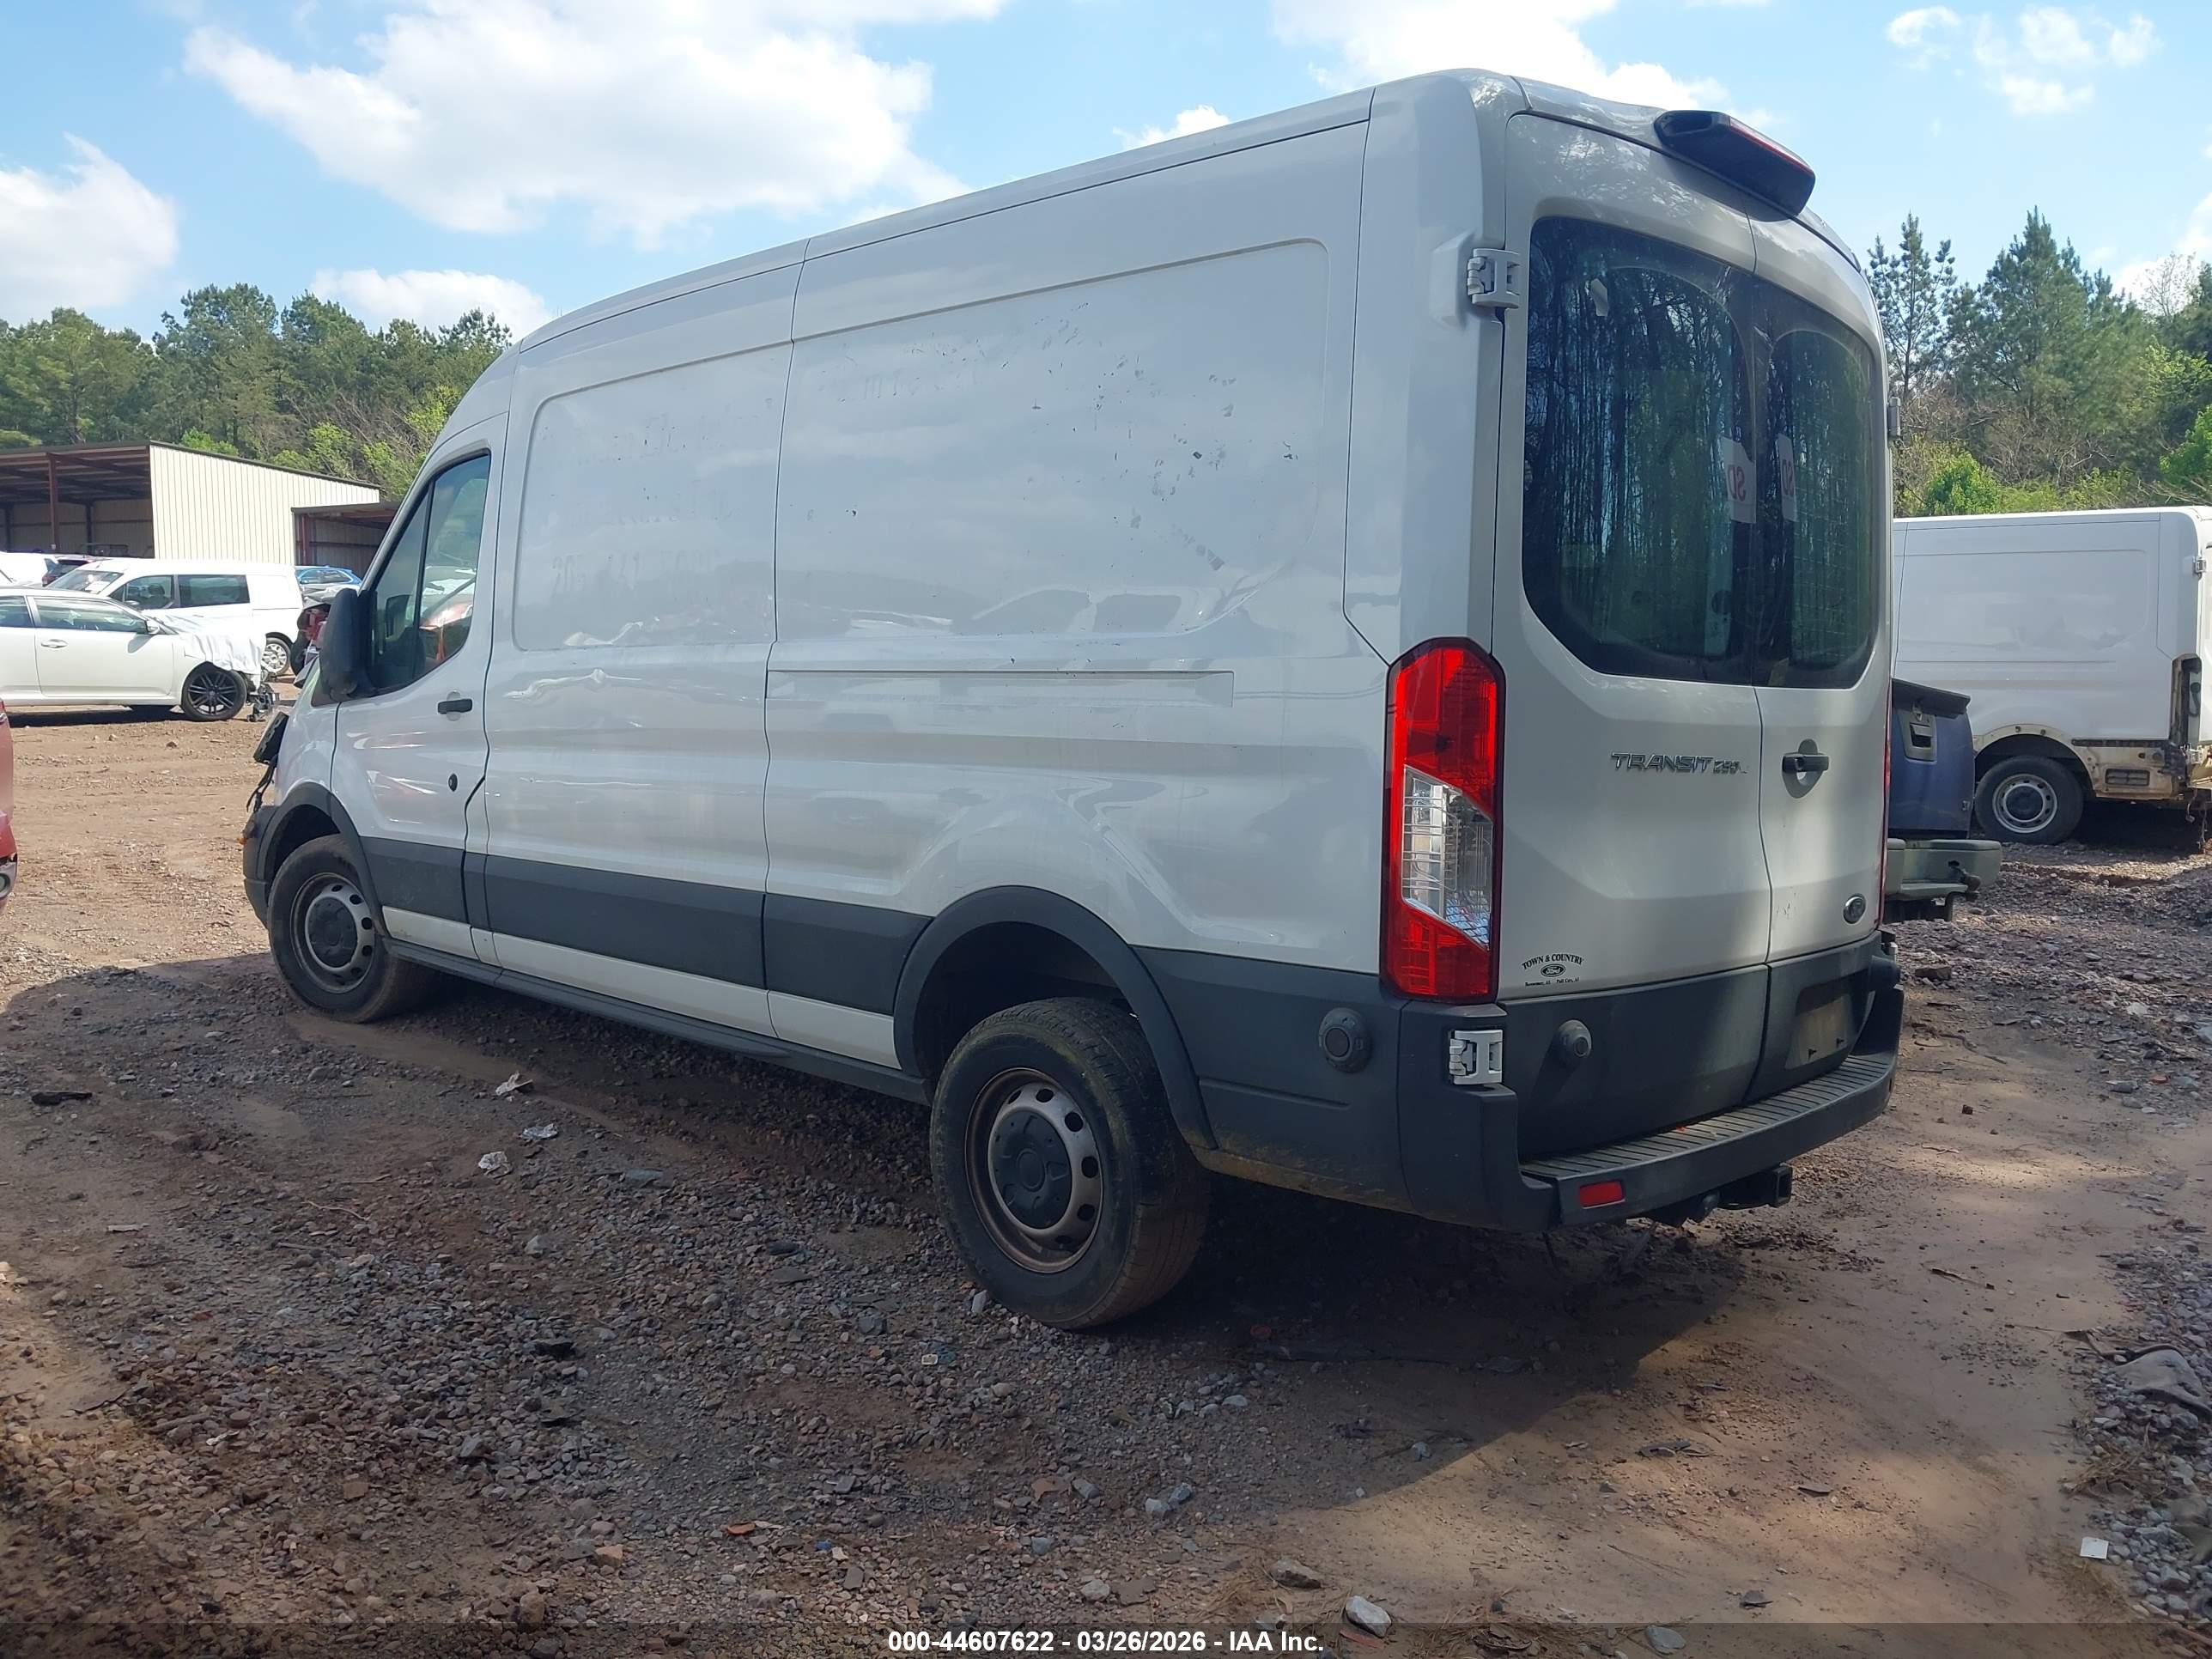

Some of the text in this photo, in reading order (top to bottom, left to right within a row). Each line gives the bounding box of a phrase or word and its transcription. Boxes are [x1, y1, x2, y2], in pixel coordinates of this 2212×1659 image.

[1611, 751, 1714, 773] TRANSIT
[1522, 953, 1583, 969] TOWN & COUNTRY
